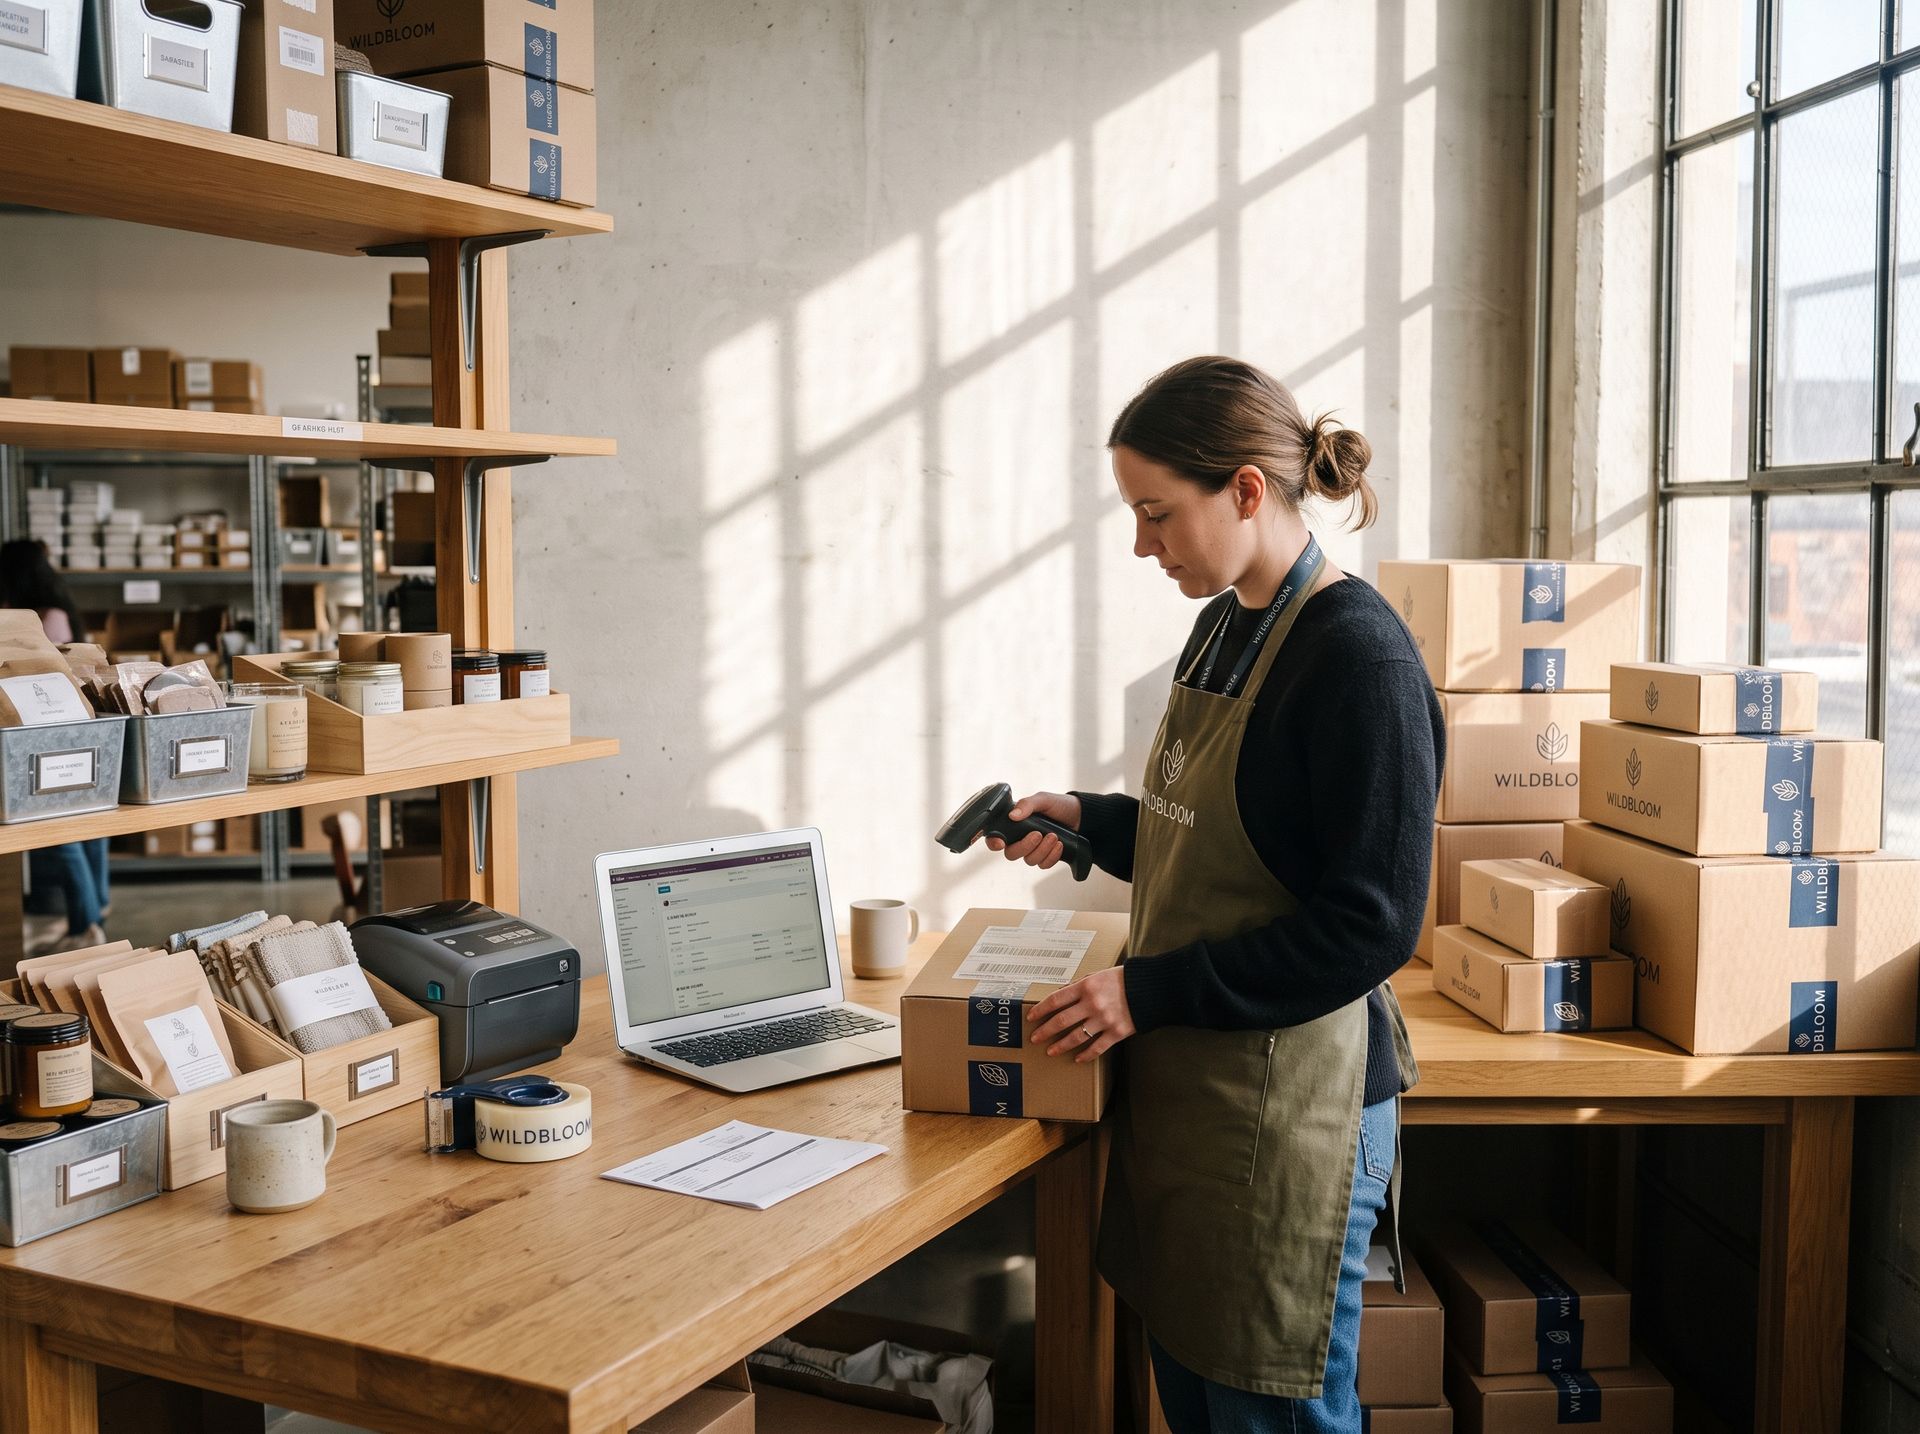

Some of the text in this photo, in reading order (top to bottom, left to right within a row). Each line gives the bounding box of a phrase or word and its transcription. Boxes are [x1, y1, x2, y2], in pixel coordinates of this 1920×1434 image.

[349, 22, 435, 49] WILDBLOOM
[1606, 790, 1661, 819] WILDBLOOM
[1813, 990, 1825, 1052] DBLOOM
